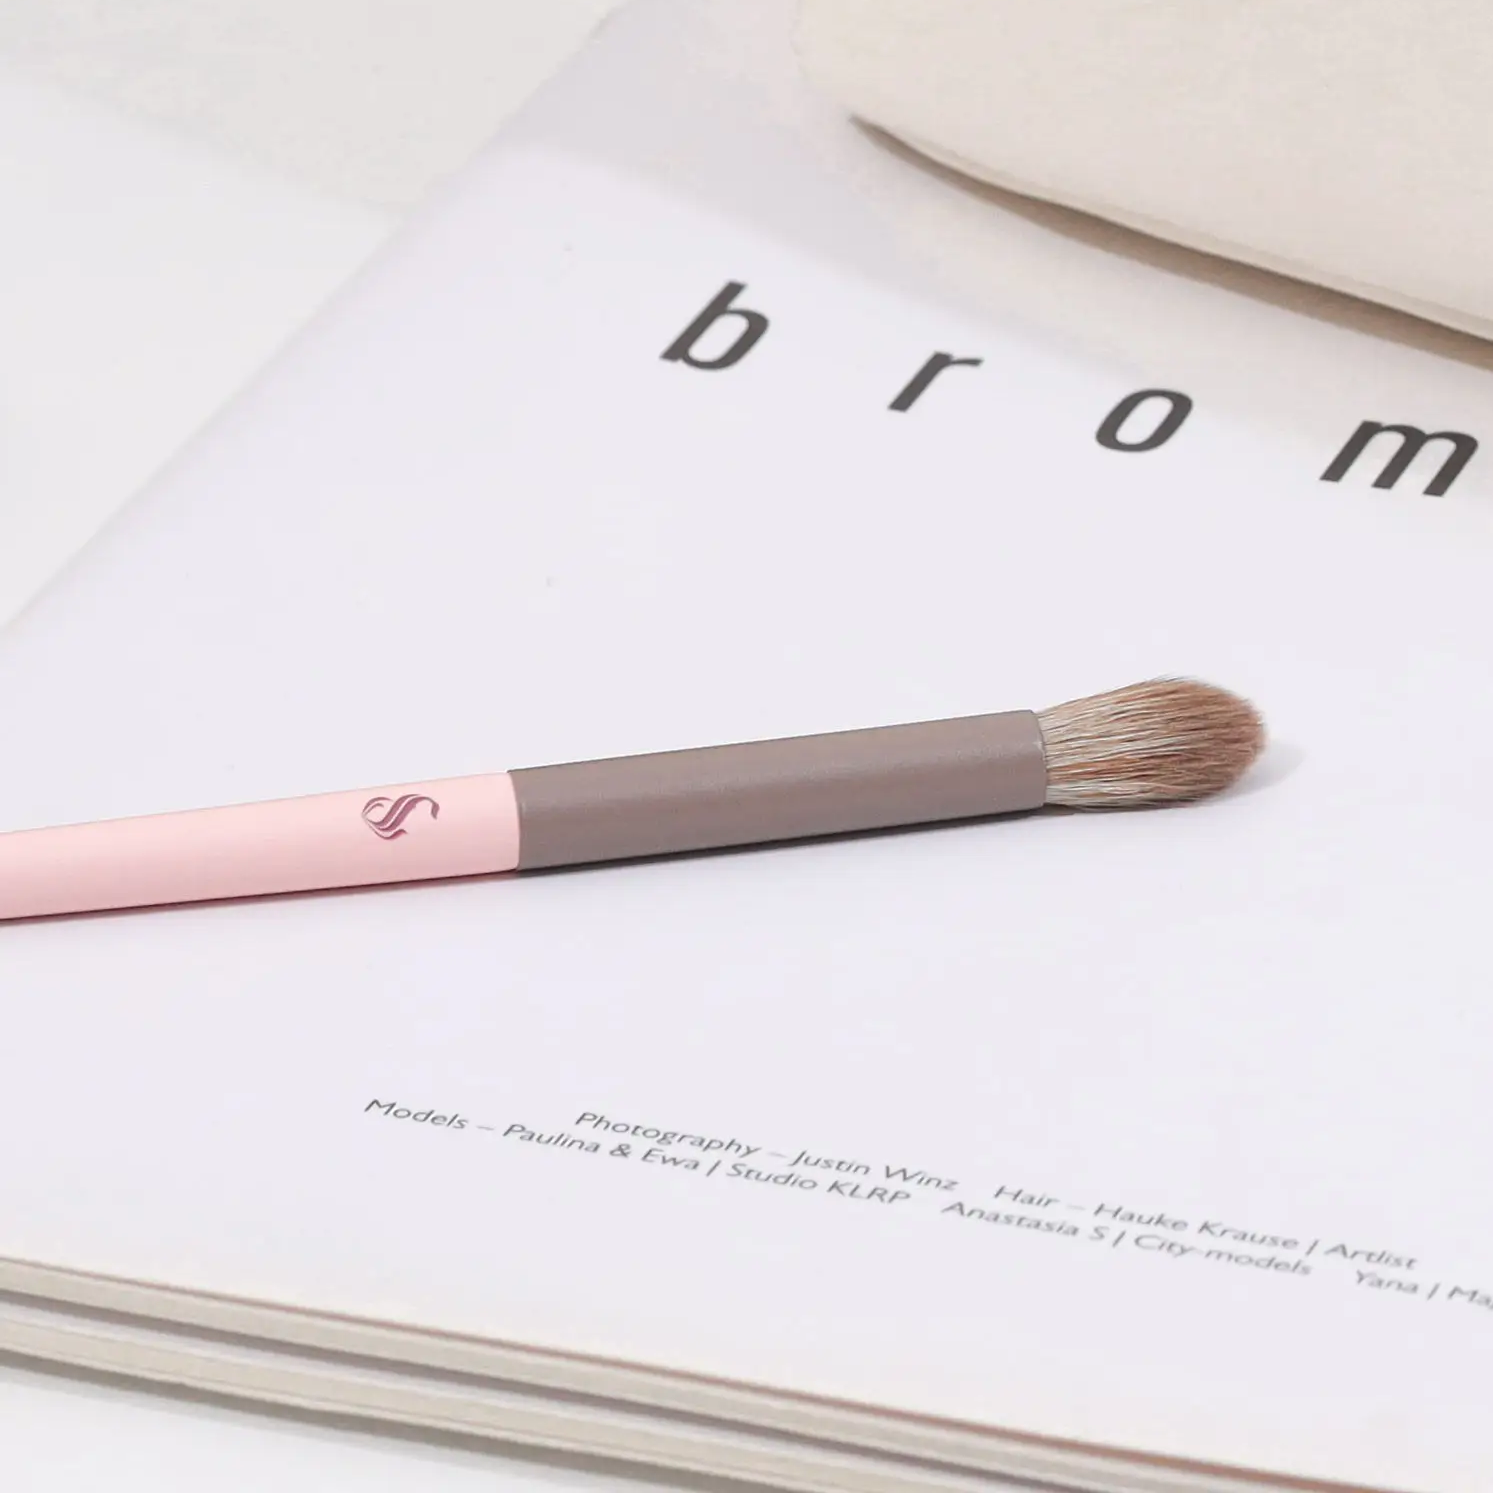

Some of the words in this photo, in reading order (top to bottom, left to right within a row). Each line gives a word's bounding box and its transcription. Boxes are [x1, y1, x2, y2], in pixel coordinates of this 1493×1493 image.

[363, 1098, 470, 1130] Models
[502, 1123, 601, 1154] Paulina
[608, 1143, 632, 1159] &
[641, 1147, 700, 1171] Ewa
[726, 1162, 819, 1191] Studio
[826, 1180, 912, 1204] KLRP
[940, 1201, 1080, 1237] Anastasia
[1355, 1270, 1419, 1295] Yana
[574, 1111, 762, 1160] Photography
[787, 1150, 871, 1176] Justin
[885, 1165, 959, 1191] Winz
[993, 1185, 1060, 1209] Hair
[1093, 1202, 1189, 1232] Hauke
[1197, 1220, 1299, 1250] Krause
